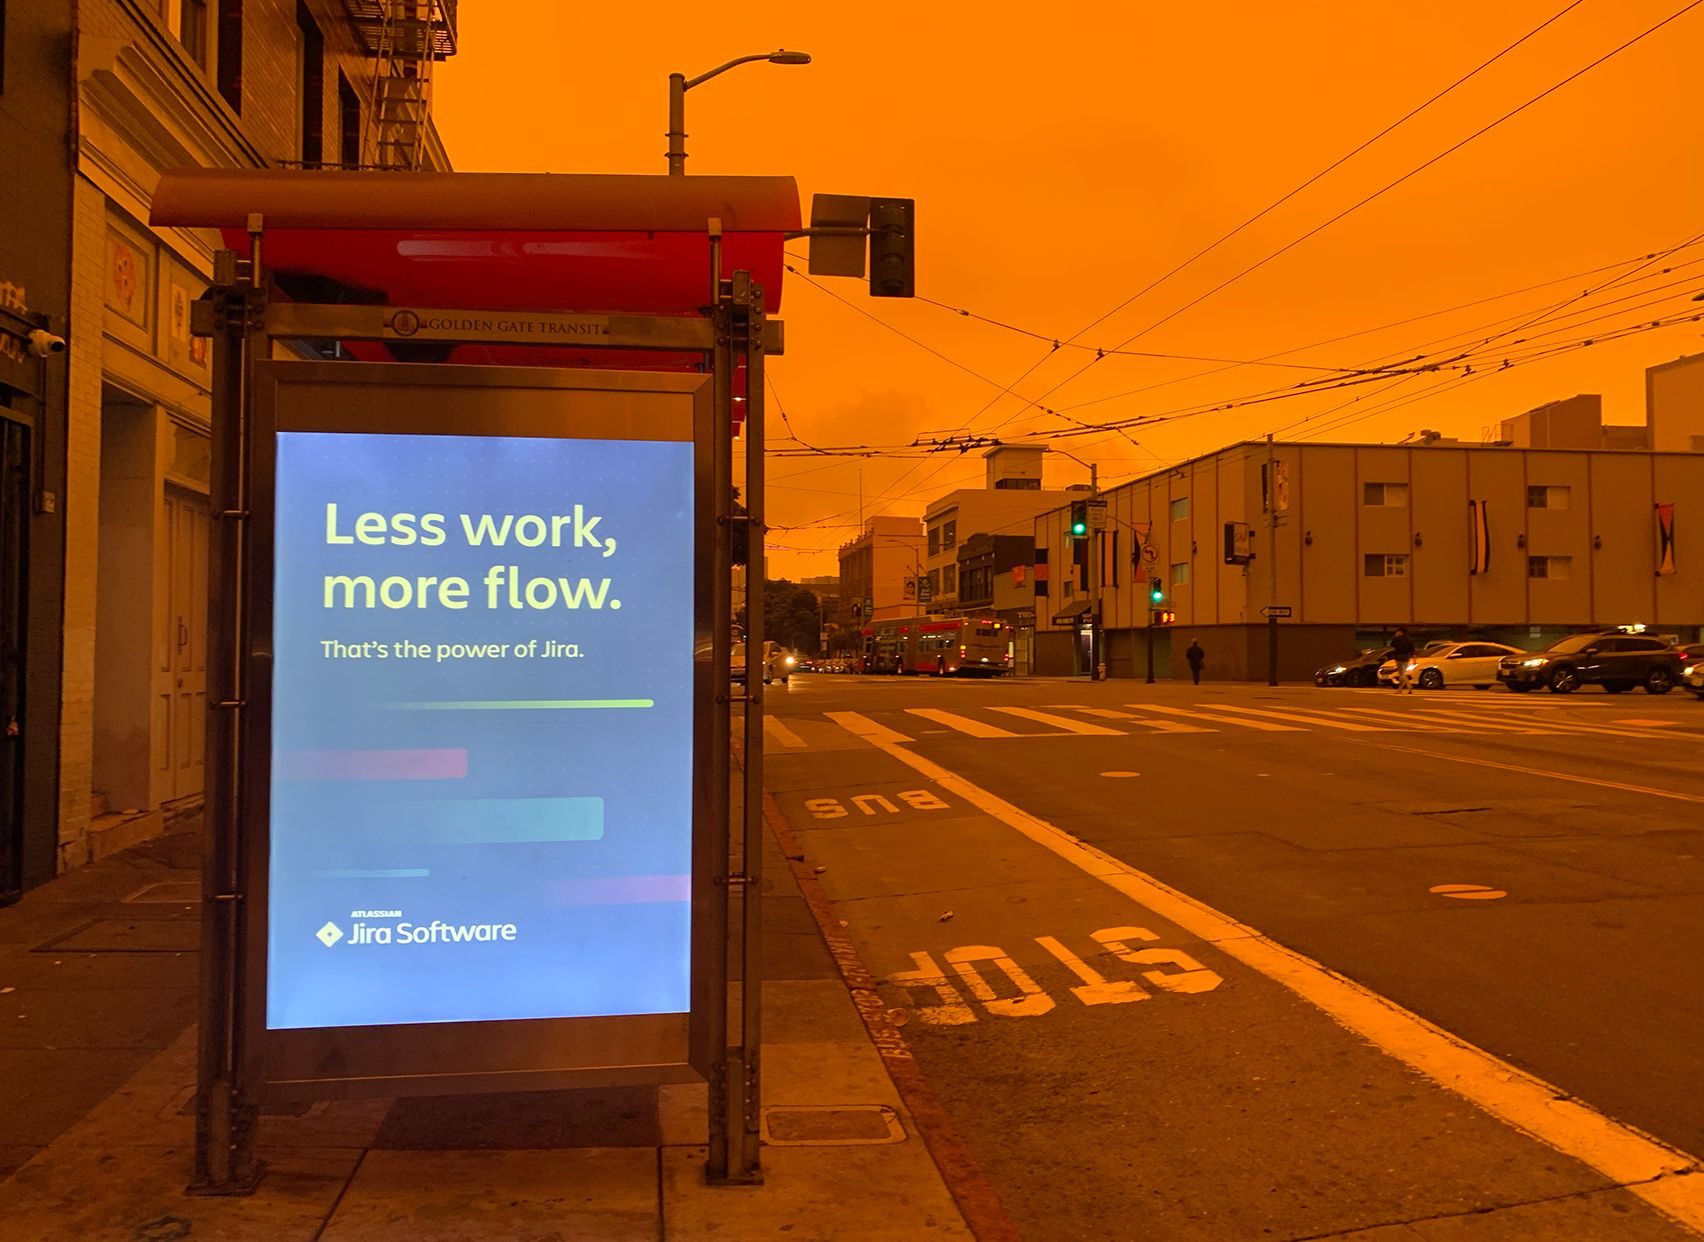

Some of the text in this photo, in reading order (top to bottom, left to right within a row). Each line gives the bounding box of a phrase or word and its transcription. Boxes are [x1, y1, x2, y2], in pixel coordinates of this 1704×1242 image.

[428, 318, 601, 336] GOLDEN GATE TRANSIT
[325, 502, 617, 558] Less work,
[323, 565, 622, 610] more flow.
[393, 640, 432, 659] the
[436, 644, 510, 663] power
[513, 640, 538, 658] of
[540, 640, 585, 659] Jira.
[804, 789, 951, 819] BUS
[350, 910, 402, 918] ATLASSIAN
[347, 920, 518, 945] Jira Software
[886, 926, 1224, 1026] STOP
